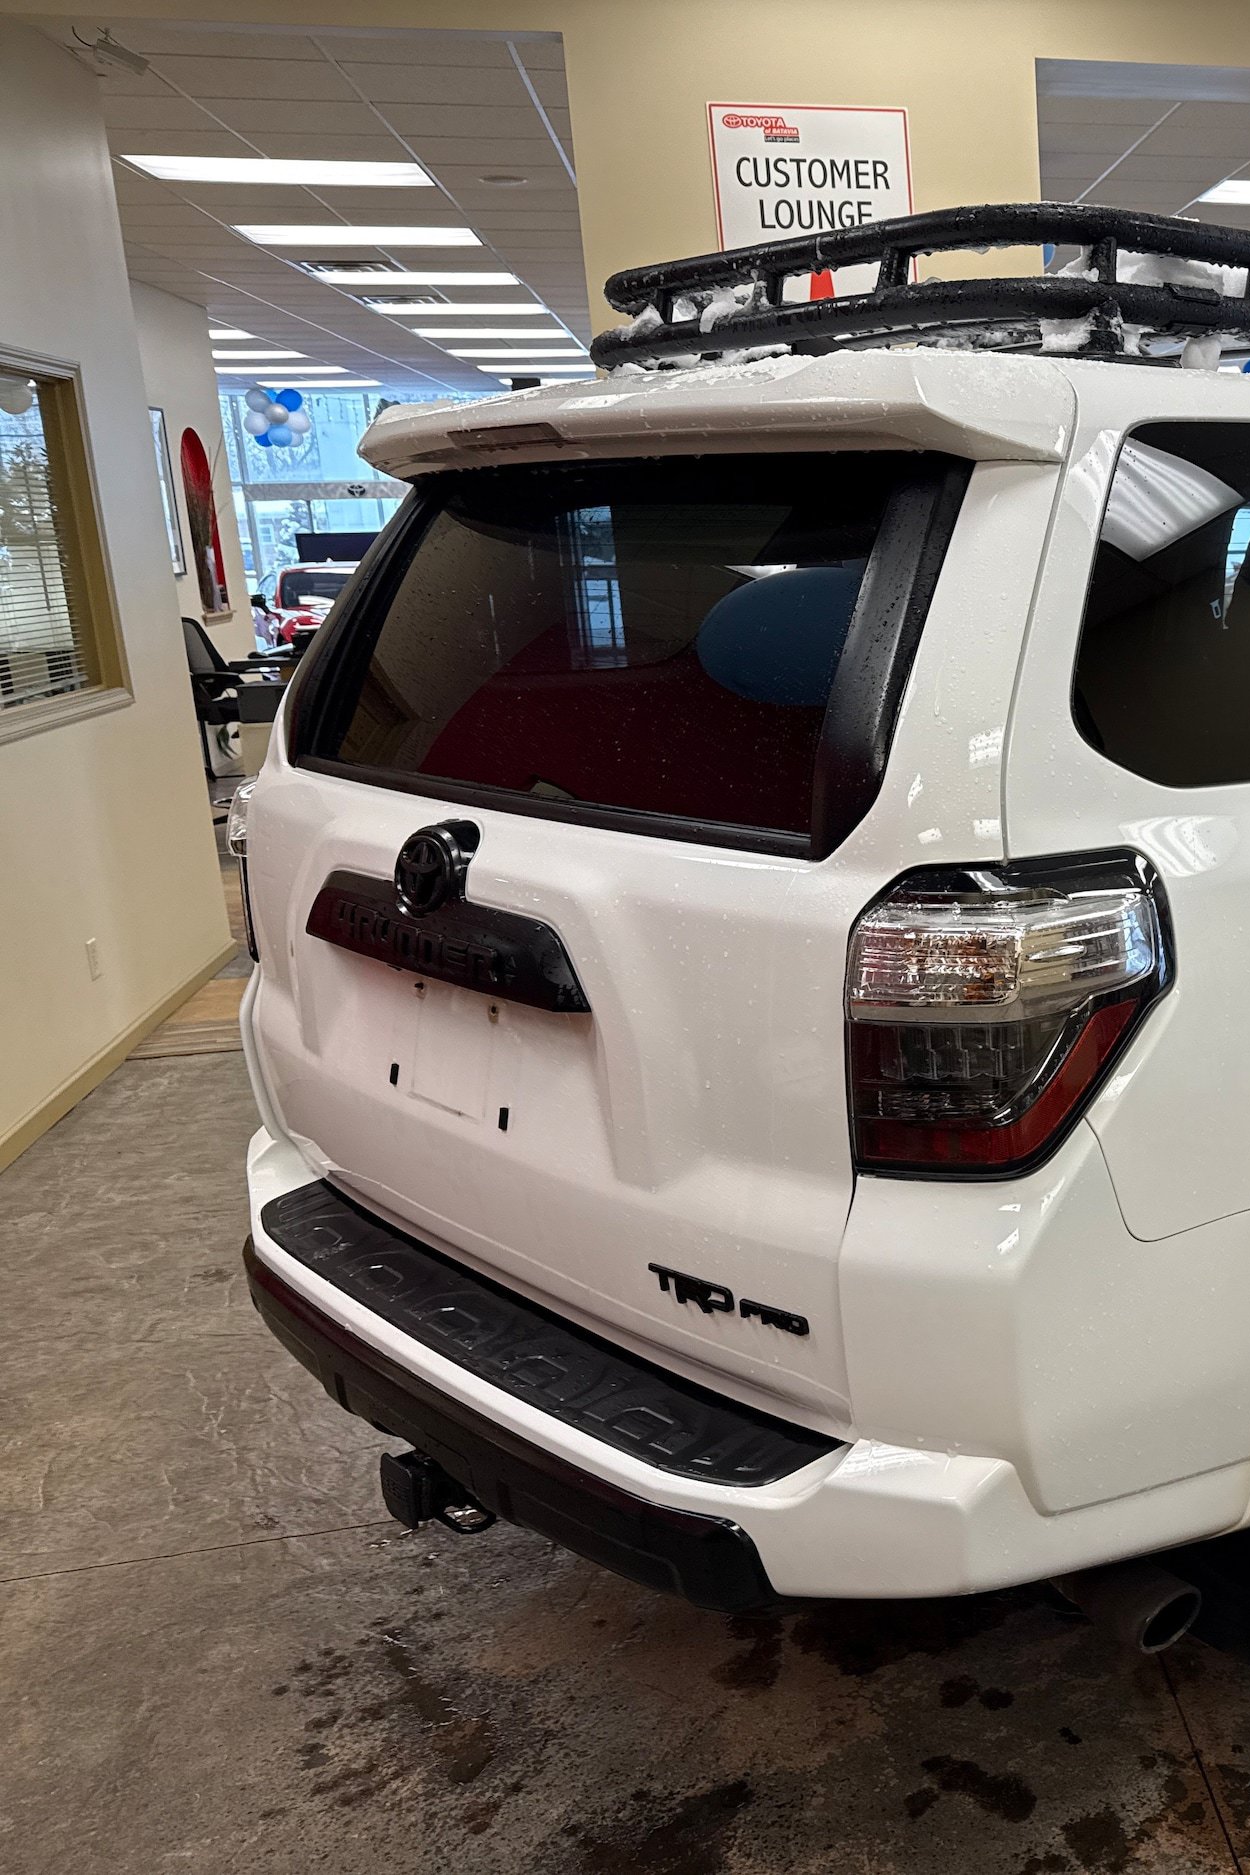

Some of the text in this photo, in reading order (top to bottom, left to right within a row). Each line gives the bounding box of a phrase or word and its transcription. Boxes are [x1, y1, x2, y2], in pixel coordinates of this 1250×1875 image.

[741, 117, 785, 127] TOYOTA
[735, 156, 891, 190] CUSTOMER
[758, 198, 873, 230] LOUNGE
[648, 1262, 810, 1337] TRD PRO
